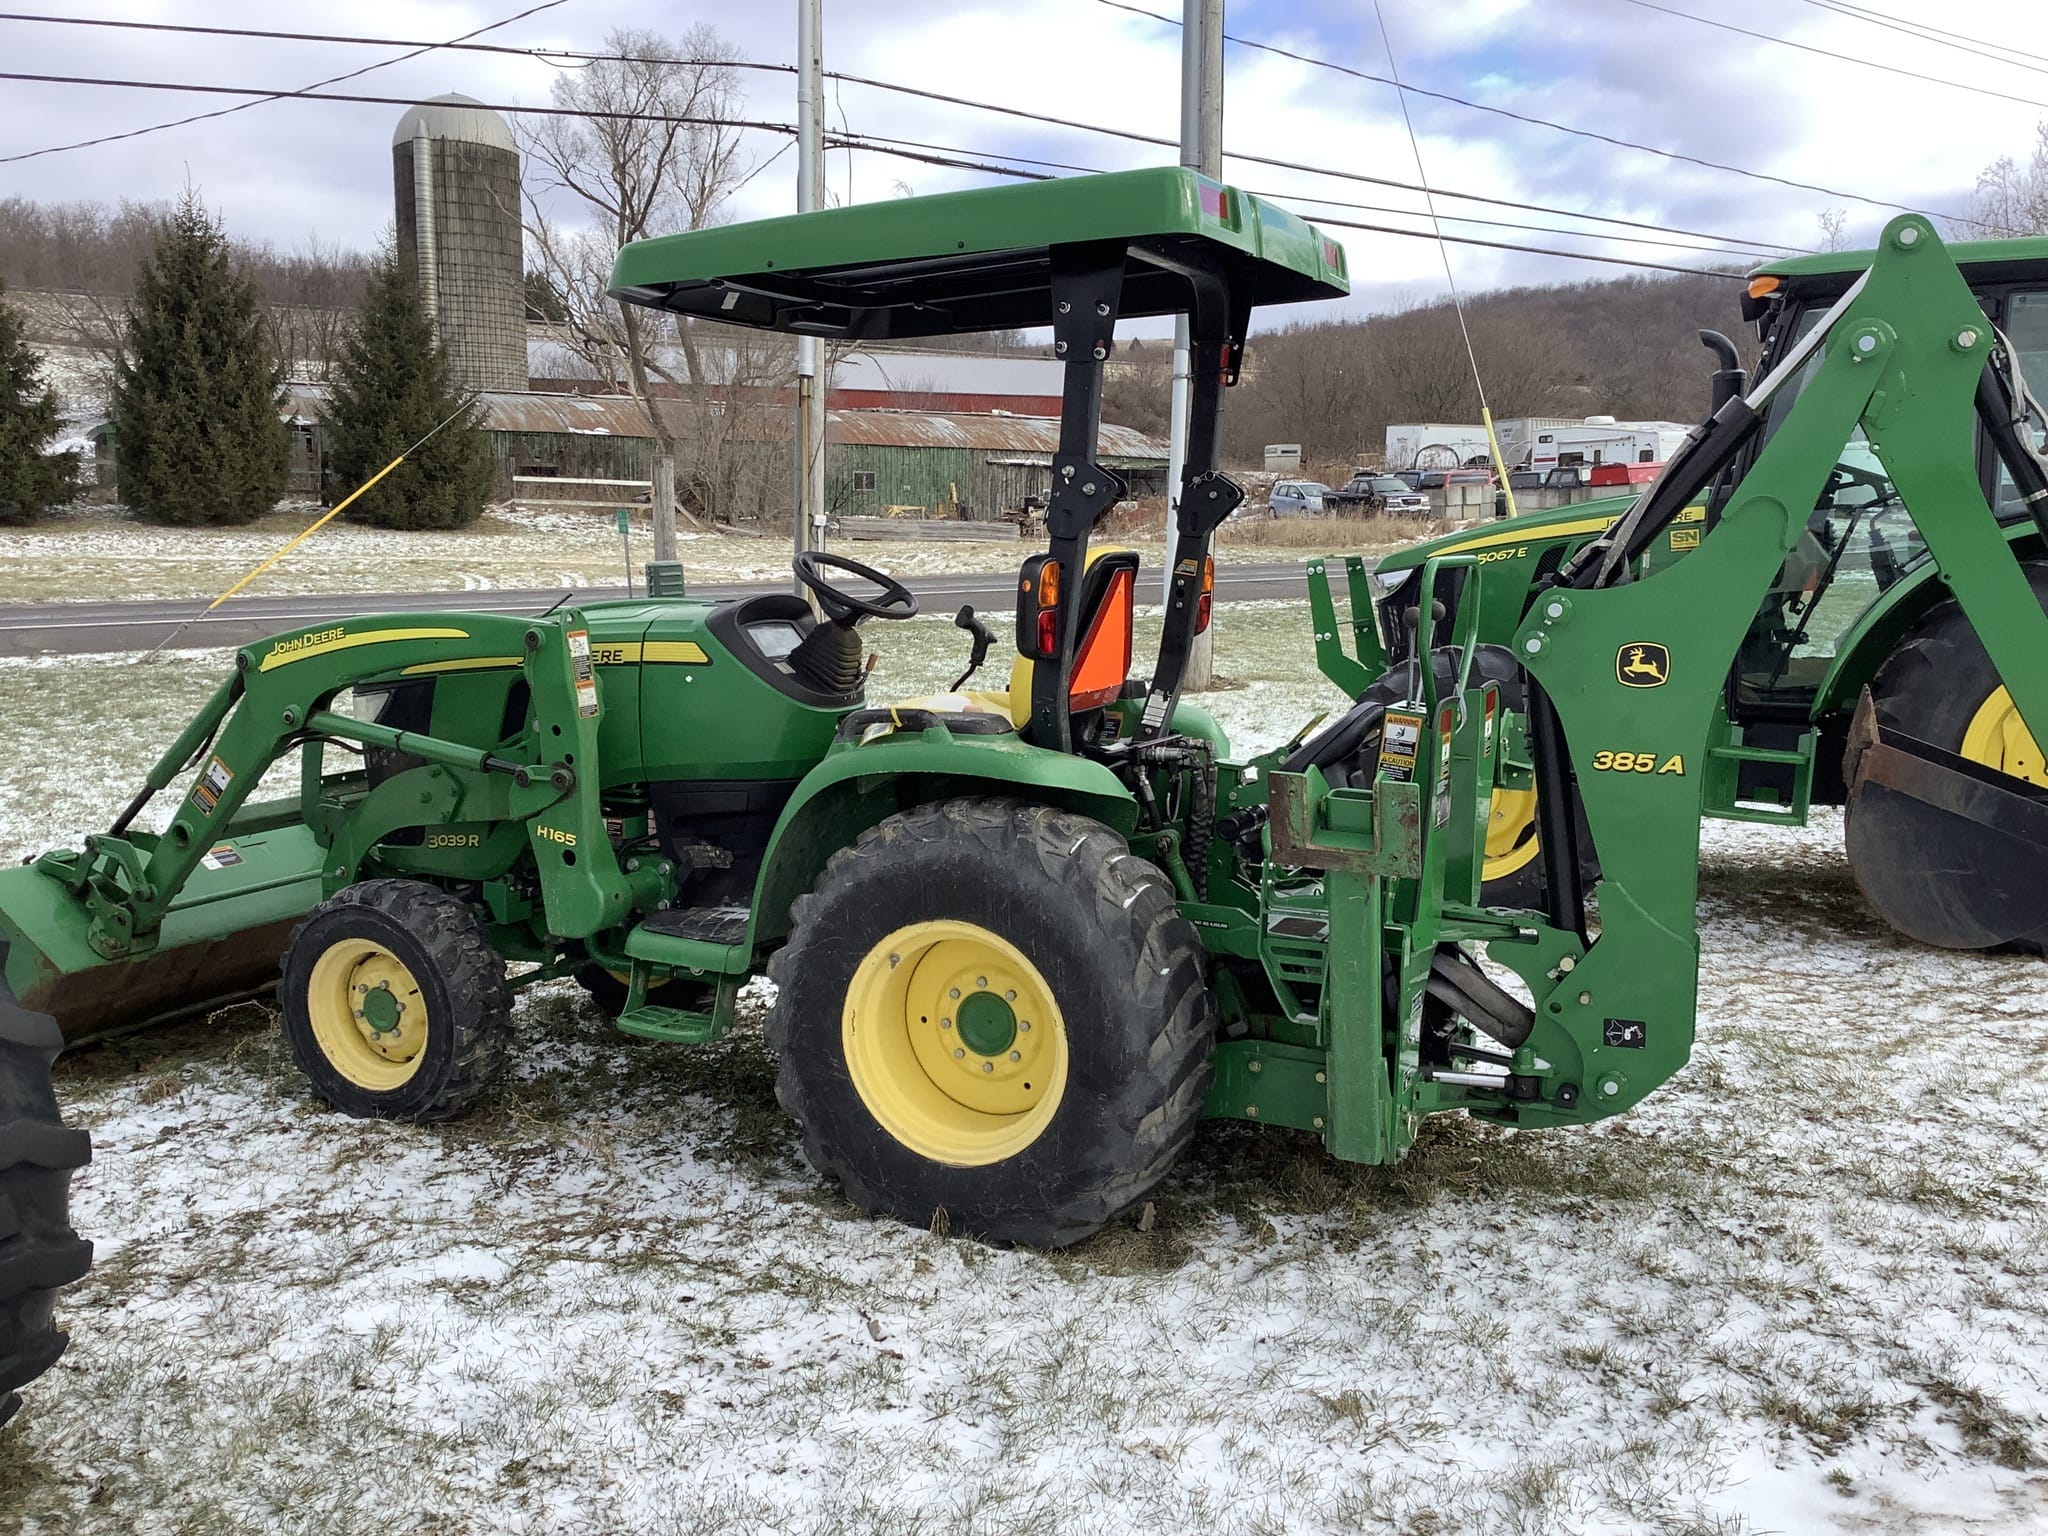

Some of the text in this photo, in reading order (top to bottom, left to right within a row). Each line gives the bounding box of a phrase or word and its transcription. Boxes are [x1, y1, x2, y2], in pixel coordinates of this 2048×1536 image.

[1671, 531, 1698, 543] SN
[270, 627, 345, 656] JOHN DEERE
[591, 649, 624, 662] ERE
[1388, 756, 1414, 768] CAUTION
[536, 824, 577, 847] H165
